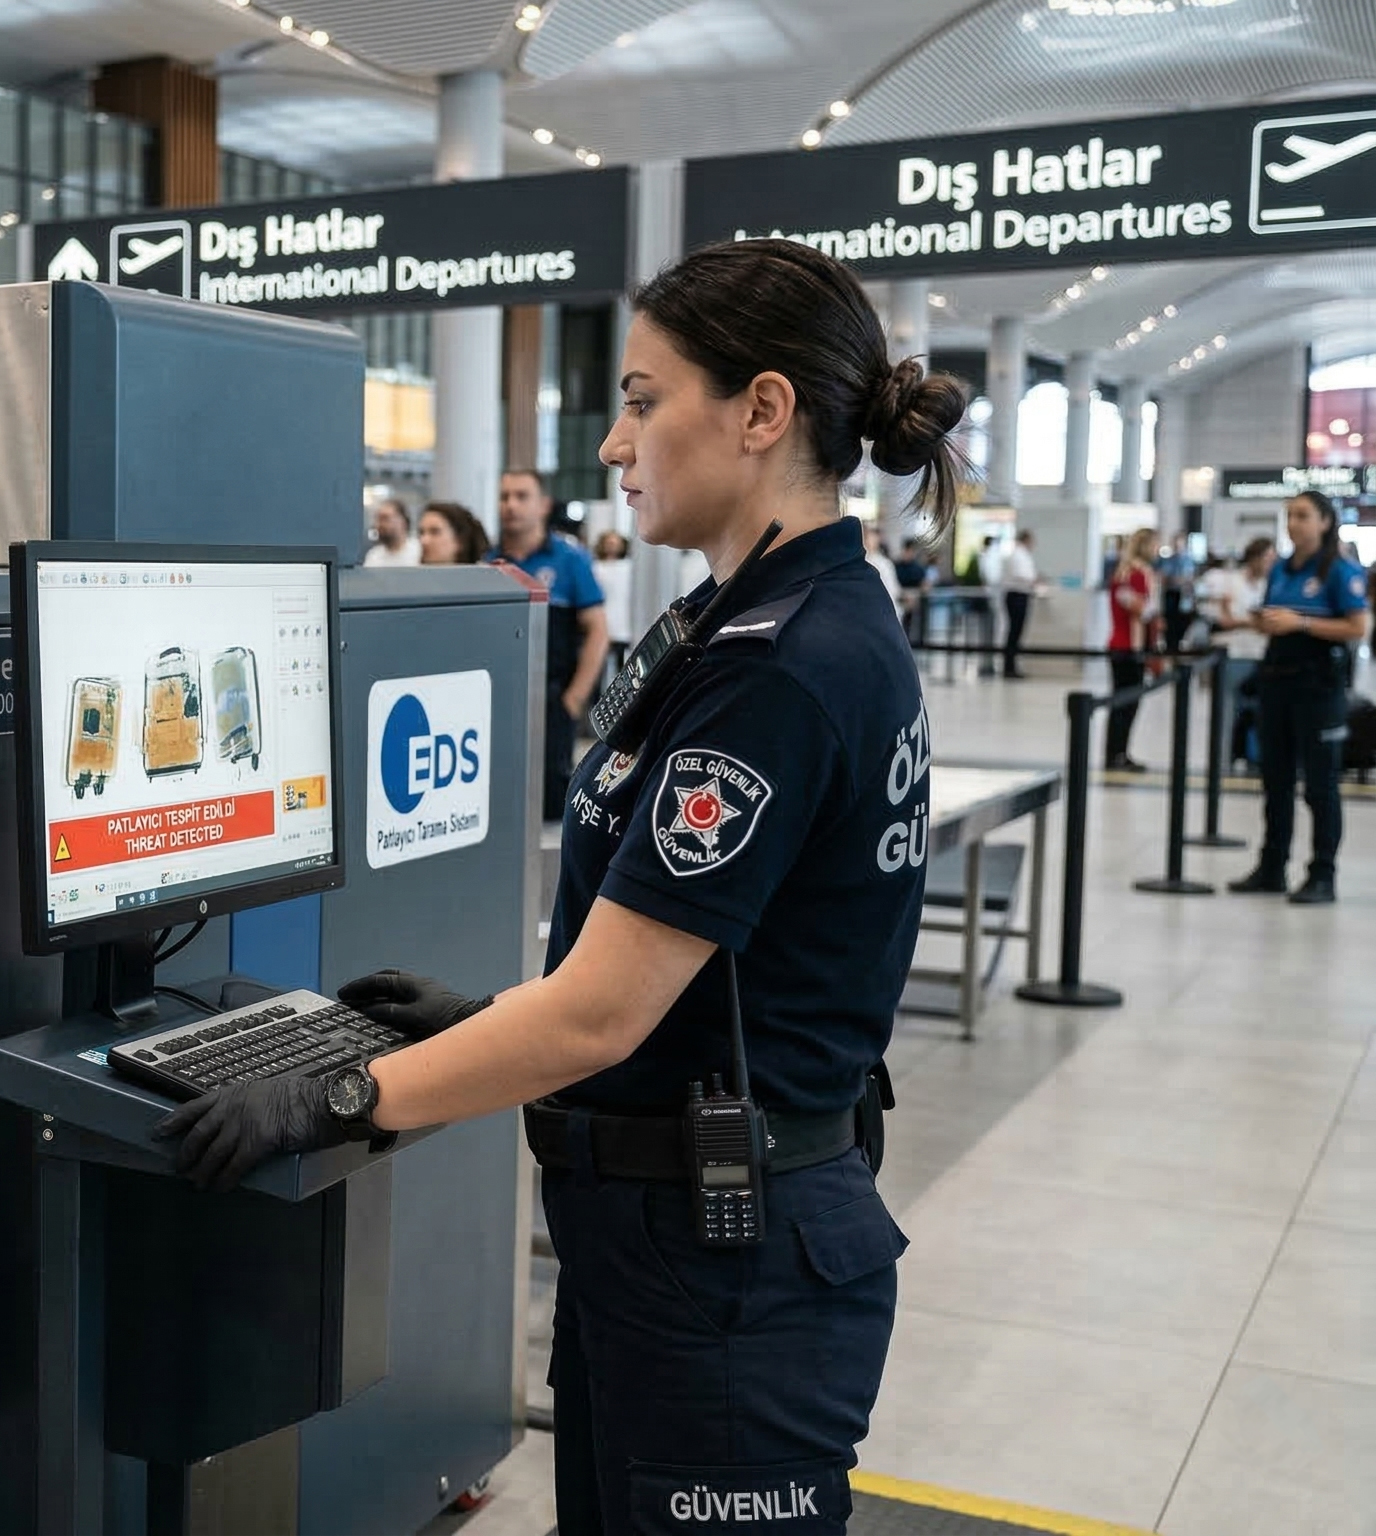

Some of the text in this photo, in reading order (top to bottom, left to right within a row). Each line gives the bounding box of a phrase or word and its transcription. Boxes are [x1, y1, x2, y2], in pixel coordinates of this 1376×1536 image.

[897, 137, 1163, 211] Dış Hatlar
[199, 207, 384, 268] Dış Hatlar
[734, 198, 1233, 260] rnational Departures
[199, 248, 575, 304] International Departures
[408, 728, 479, 795] EDS
[675, 755, 763, 802] ÖZEL GÜVENLİK
[107, 812, 162, 836] PATLAYICI
[164, 803, 201, 827] TESPİT
[571, 788, 622, 836] AYŞE Y.
[124, 824, 224, 855] THREAT DETECTED
[658, 826, 722, 864] GÜVENLİK
[670, 1480, 820, 1522] GÜVENLİK
